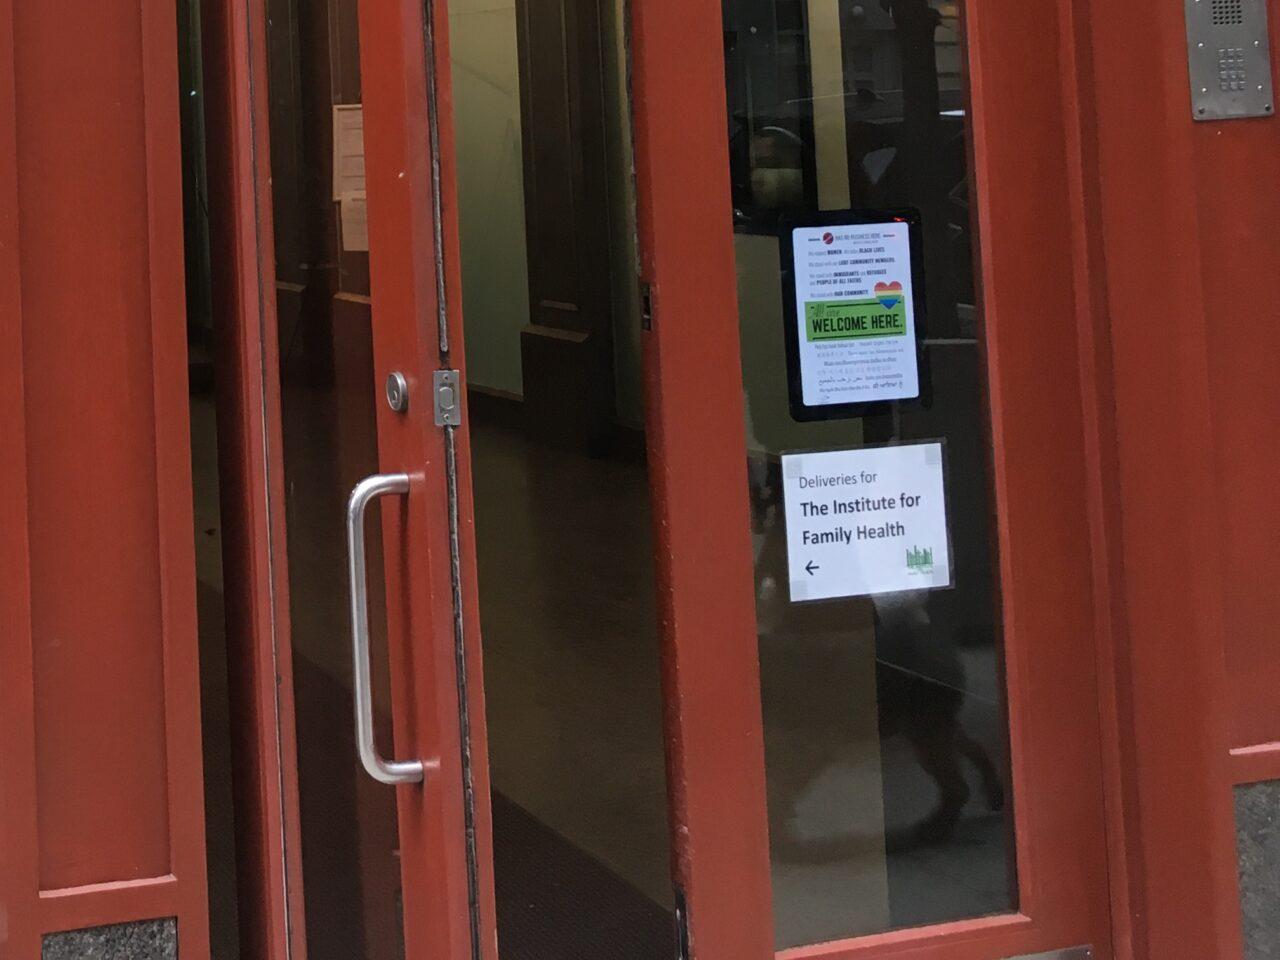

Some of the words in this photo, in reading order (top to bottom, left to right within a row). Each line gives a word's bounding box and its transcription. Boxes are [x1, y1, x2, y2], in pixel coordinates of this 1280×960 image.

[812, 315, 868, 334] WELCOME
[871, 313, 904, 330] HERE.
[799, 474, 858, 489] Deliveries
[860, 470, 878, 484] for
[800, 500, 829, 517] The
[833, 496, 896, 515] Institute
[899, 492, 921, 508] for
[802, 526, 852, 545] Family
[856, 521, 905, 540] Health
